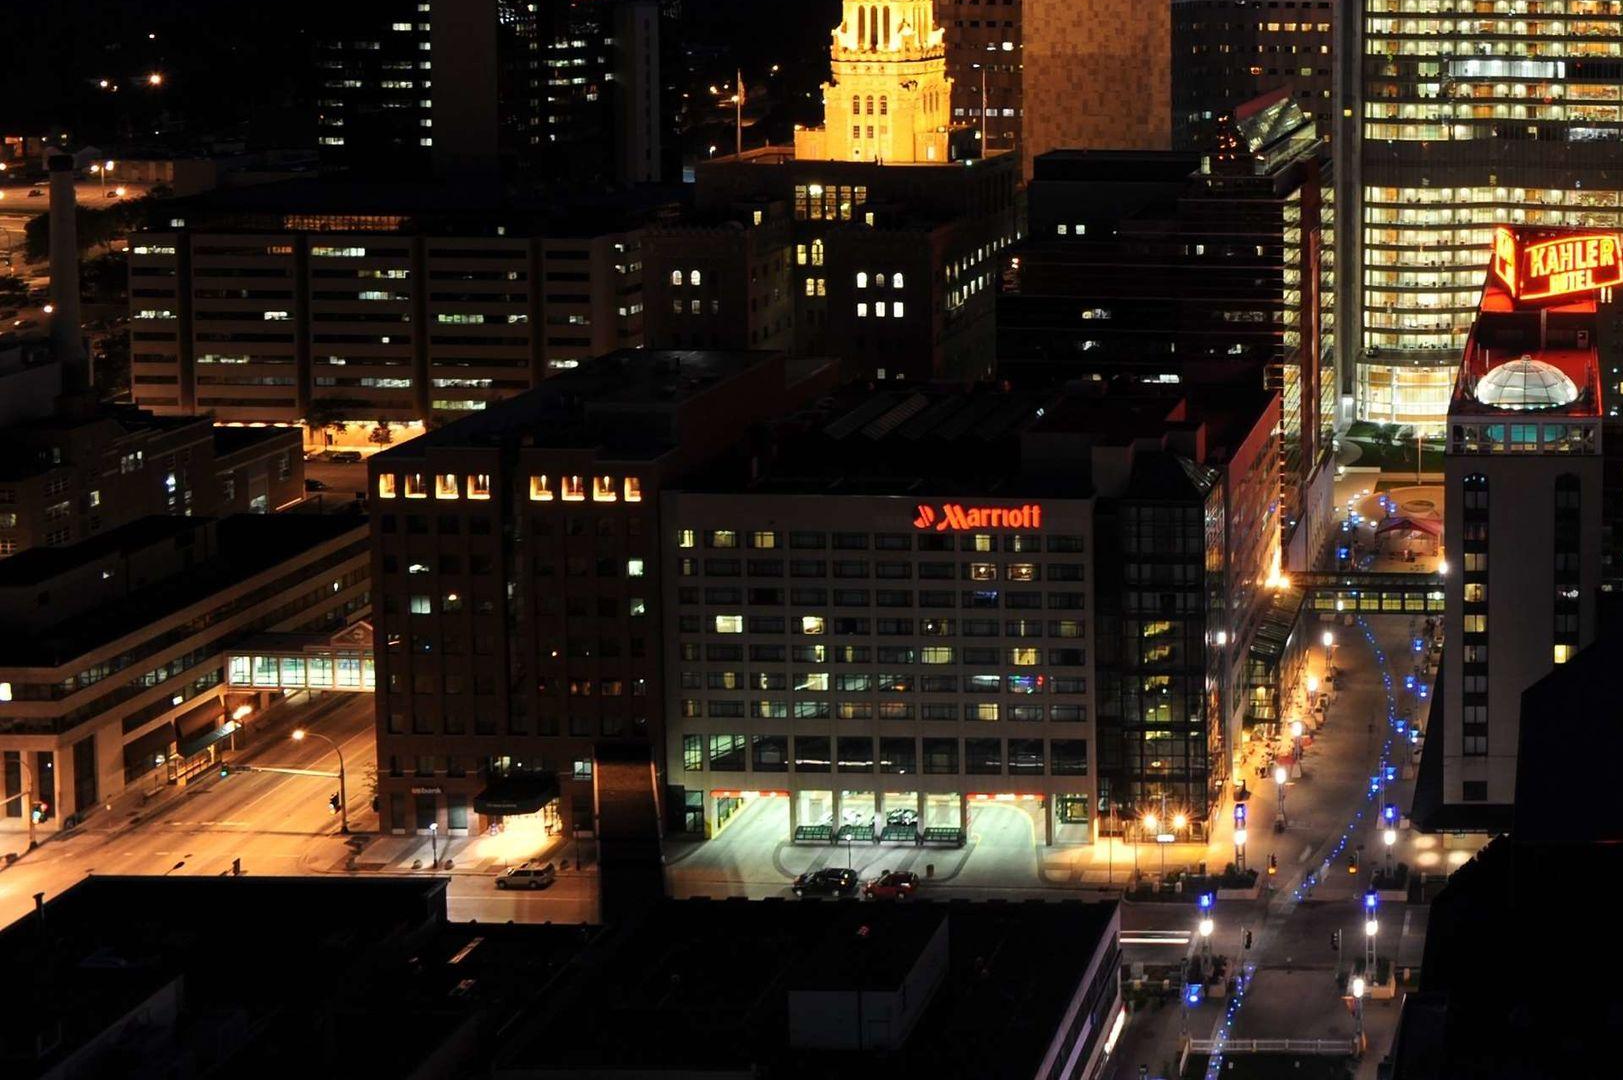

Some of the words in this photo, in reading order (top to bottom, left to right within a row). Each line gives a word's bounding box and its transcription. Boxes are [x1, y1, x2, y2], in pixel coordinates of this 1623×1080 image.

[1531, 238, 1614, 277] KAHLER
[1549, 269, 1595, 292] TEL
[936, 503, 1042, 531] Marriott
